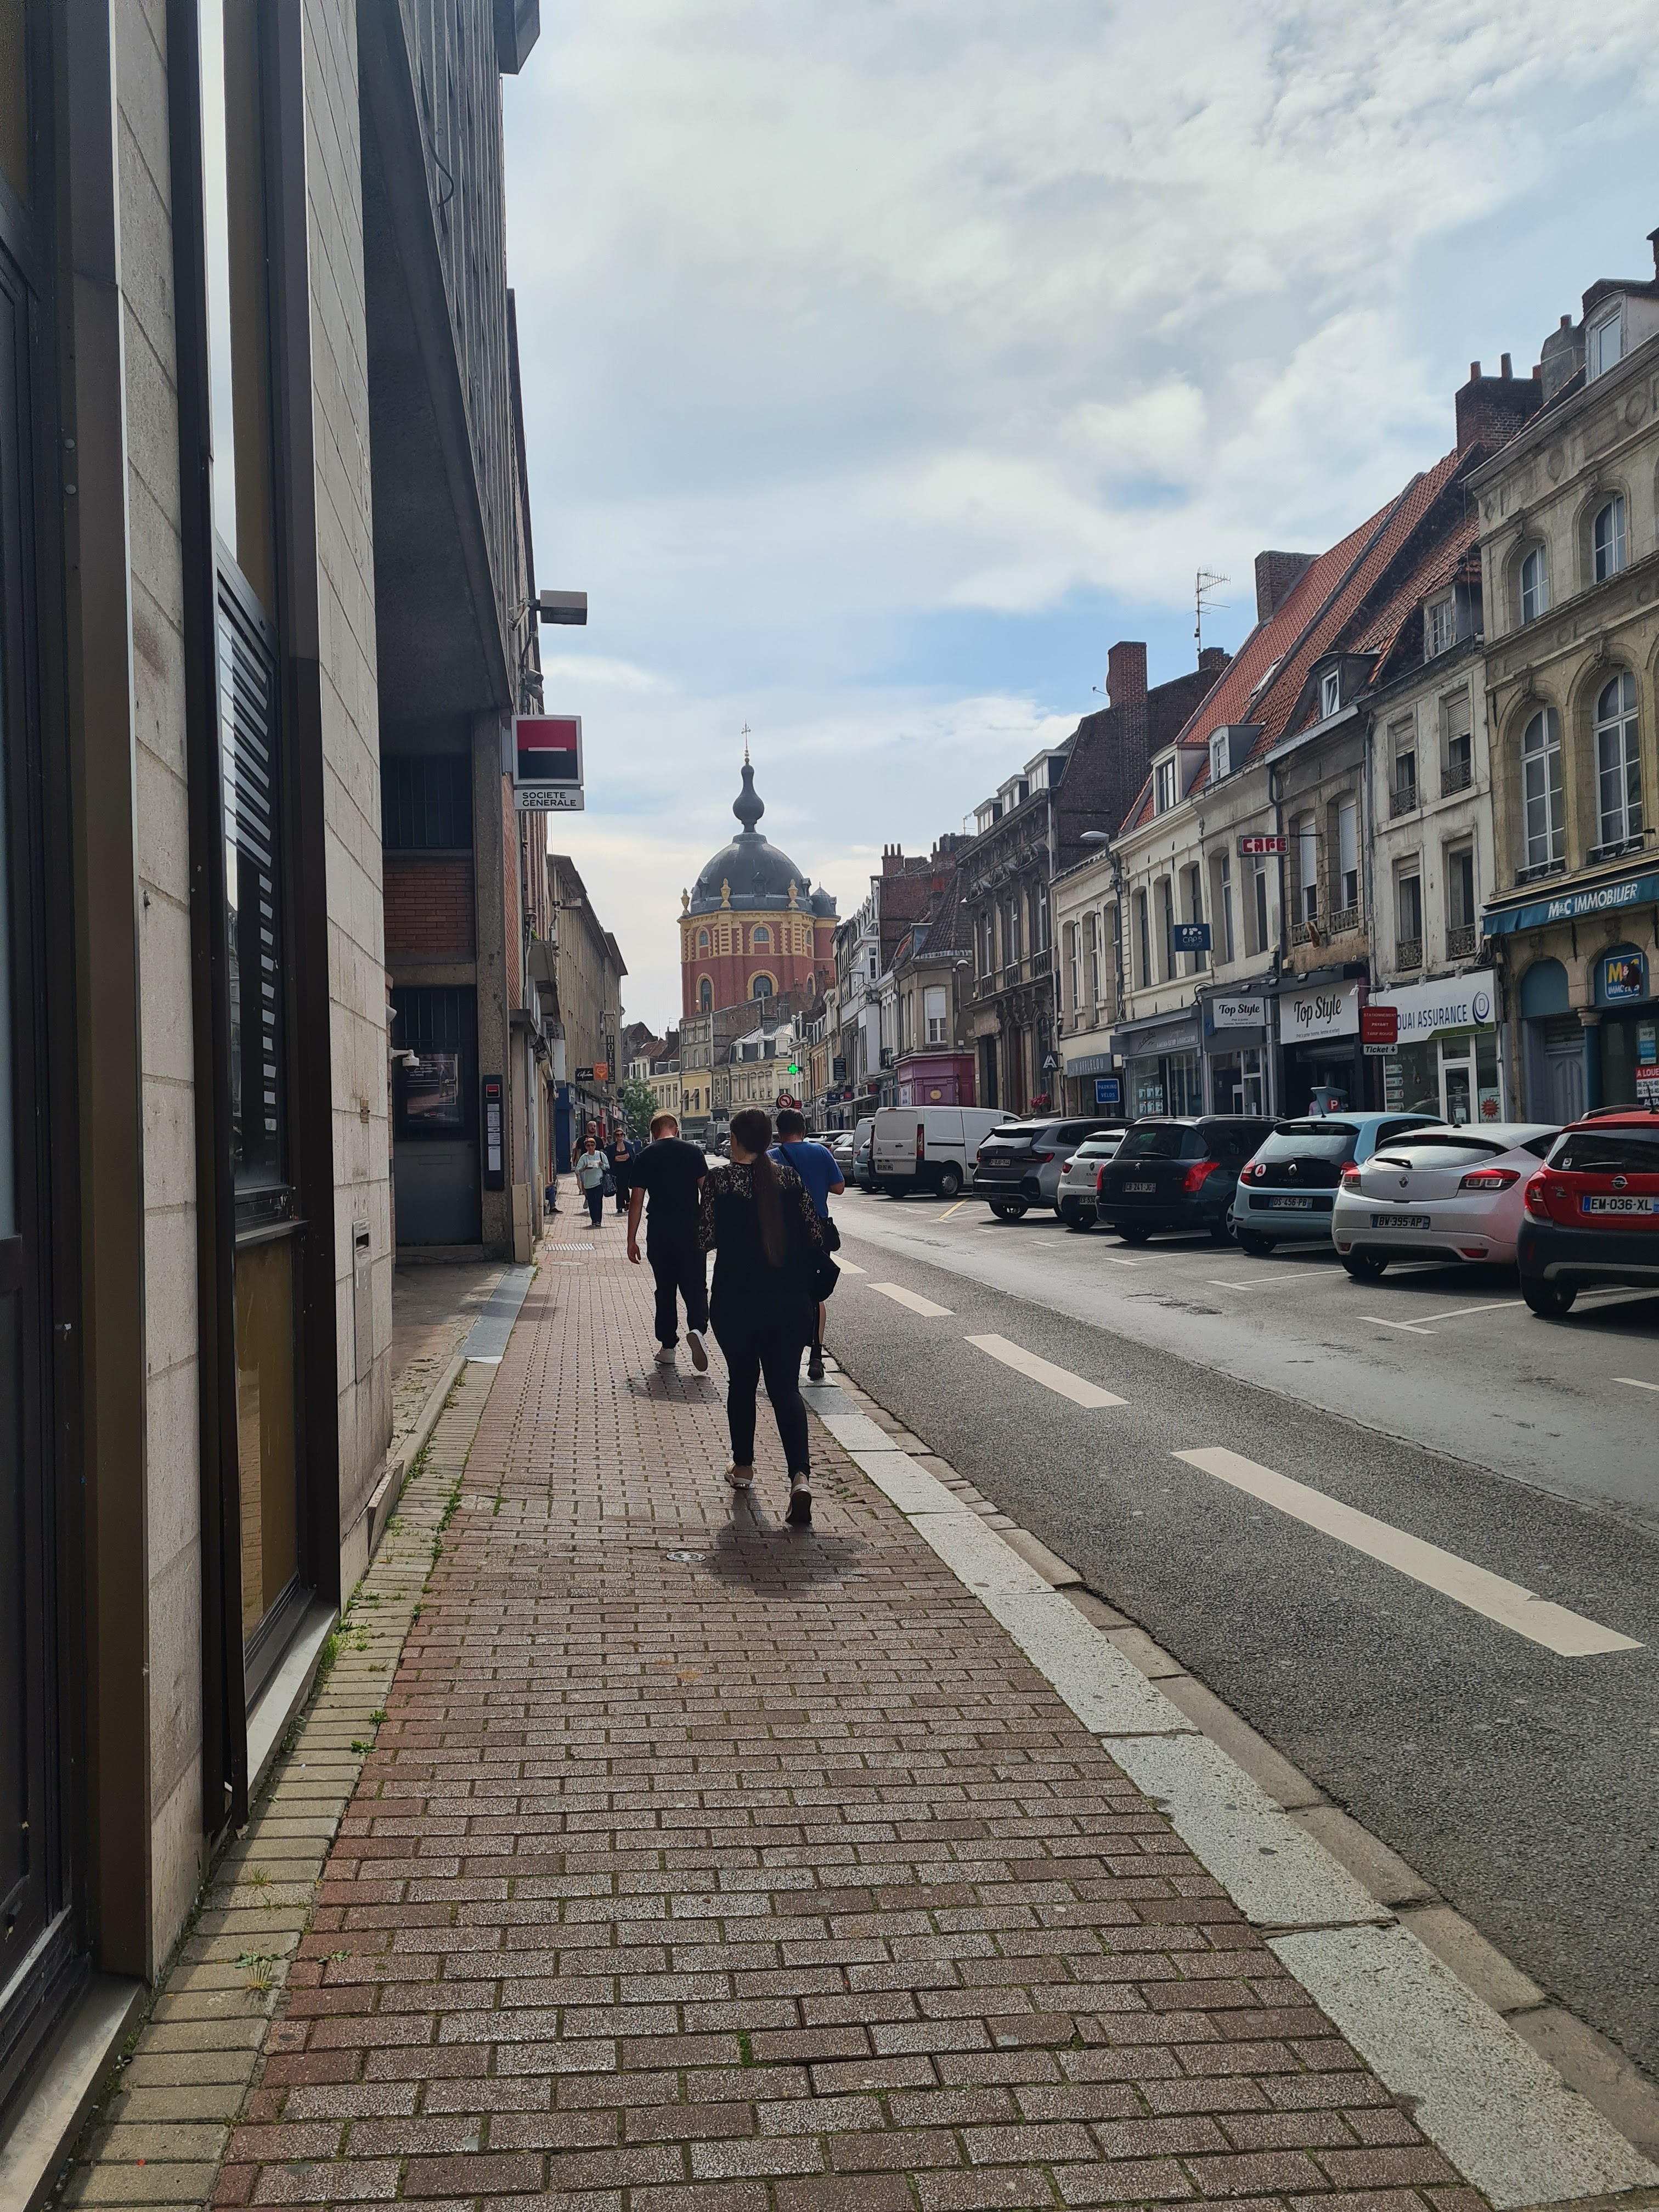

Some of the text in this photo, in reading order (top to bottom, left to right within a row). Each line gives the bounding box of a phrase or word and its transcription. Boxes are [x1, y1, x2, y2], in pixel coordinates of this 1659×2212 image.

[1243, 837, 1286, 853] CAFE
[1548, 883, 1638, 918] M&C IMMOBILIER
[1608, 958, 1640, 984] M&
[1218, 1003, 1260, 1017] Top Style
[1294, 994, 1342, 1028] Top Style
[1397, 1004, 1468, 1031] OUAI ASSURANCE
[1637, 1068, 1659, 1078] A LOUE
[1331, 1100, 1338, 1109] P
[1257, 1165, 1263, 1175] A
[1274, 1198, 1307, 1206] DS-456-PB
[1591, 1198, 1652, 1211] EM-036-XL
[1379, 1216, 1422, 1227] BW-395-AP
